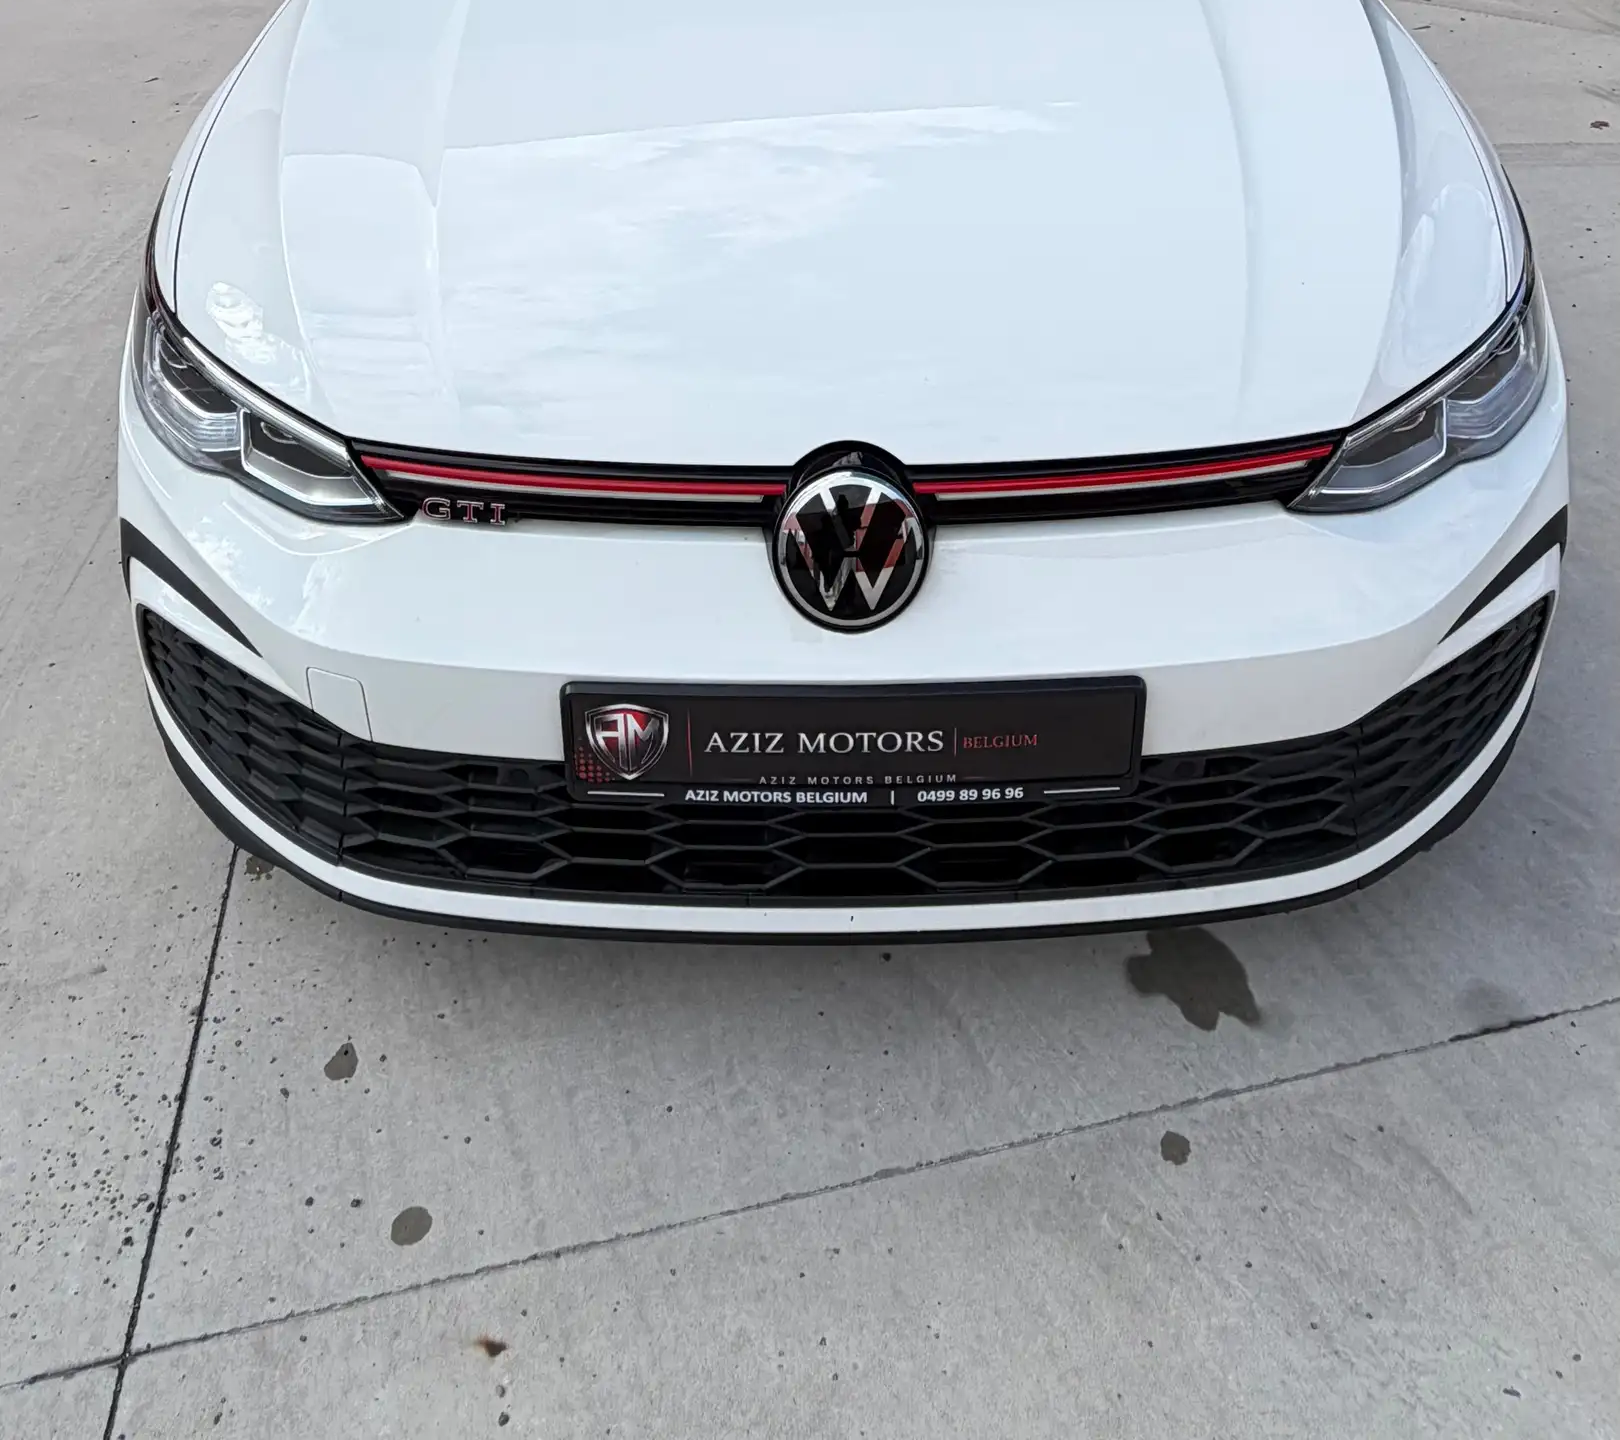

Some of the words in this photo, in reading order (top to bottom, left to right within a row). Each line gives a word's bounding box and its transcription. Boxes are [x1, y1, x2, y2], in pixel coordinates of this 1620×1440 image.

[421, 497, 506, 526] GTI
[704, 732, 785, 754] AZIZ
[797, 730, 944, 754] MOTORS
[962, 734, 1038, 749] BELGIUM
[759, 776, 797, 785] AZIZ
[807, 775, 875, 785] MOTORS
[884, 774, 957, 785] BELGIUM
[685, 789, 719, 802] AZIZ
[723, 790, 792, 803] MOTORS
[796, 790, 868, 804] BELGIUM
[917, 790, 955, 803] 0499
[959, 789, 978, 802] 89
[982, 788, 1001, 800] 96
[1004, 787, 1024, 800] 96
